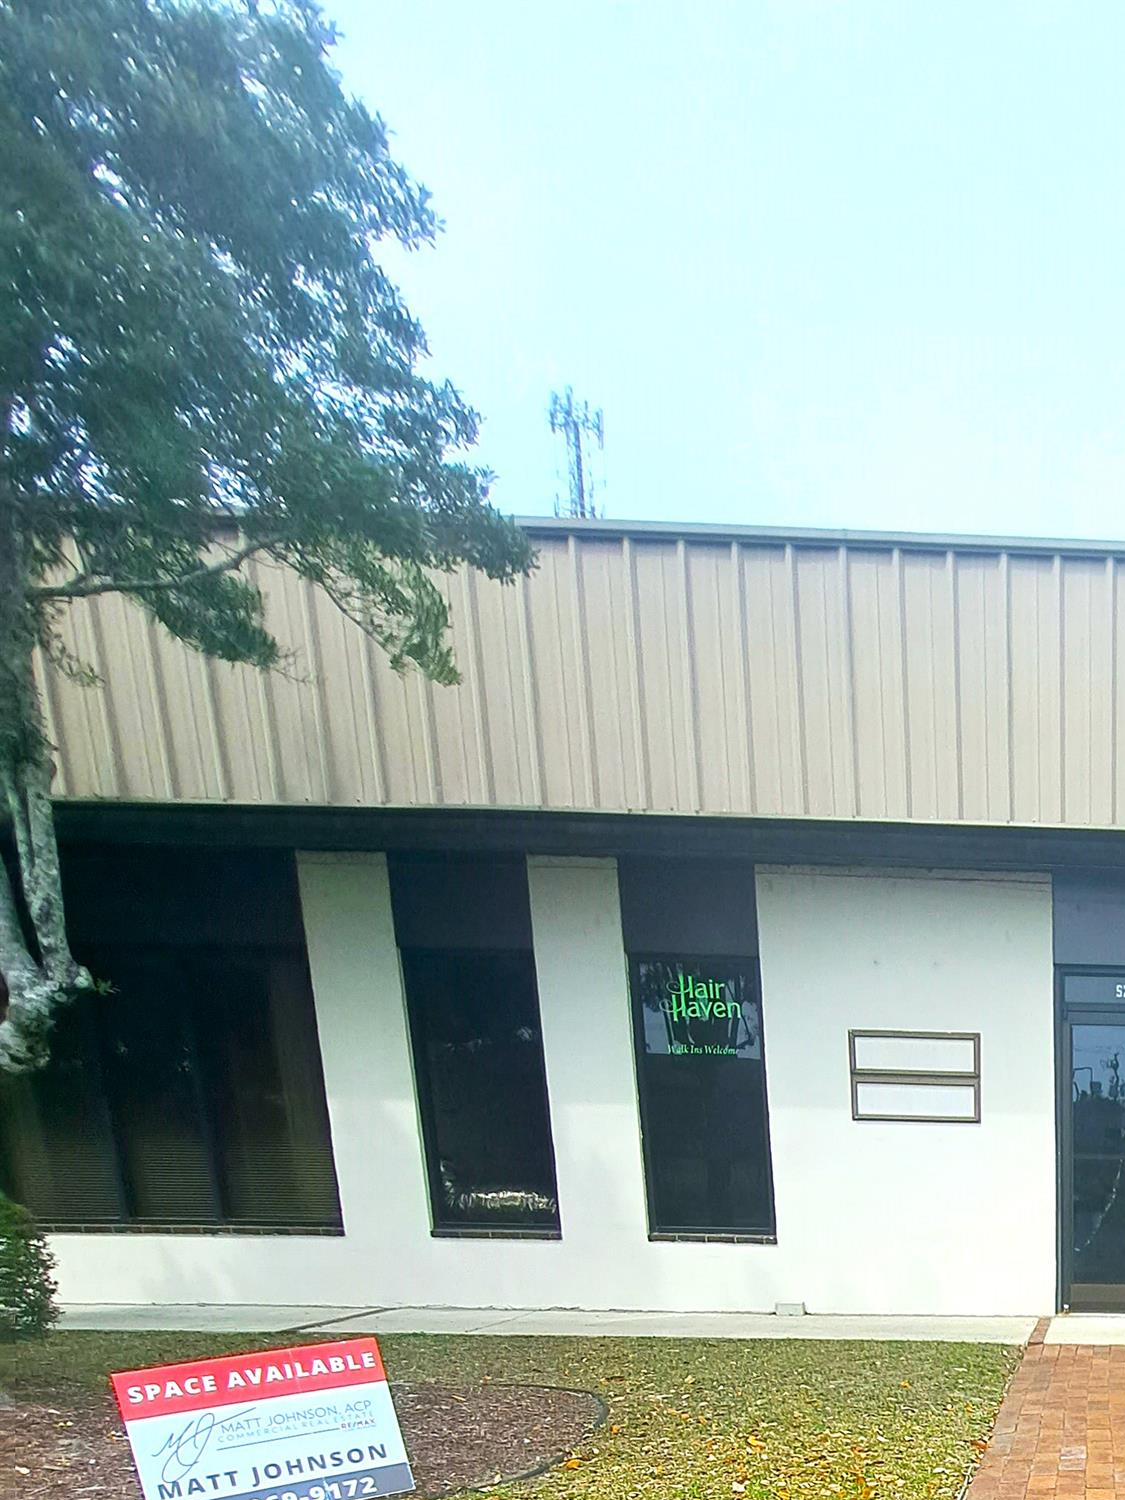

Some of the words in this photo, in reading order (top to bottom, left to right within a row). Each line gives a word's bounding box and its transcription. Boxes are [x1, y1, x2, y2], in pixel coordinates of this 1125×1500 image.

[666, 974, 726, 999] Hair
[659, 994, 742, 1022] Haven
[667, 1044, 689, 1055] Walk
[690, 1045, 703, 1055] Ins
[127, 1375, 218, 1405] SPACE
[227, 1352, 377, 1389] AVAILABLE
[217, 1424, 298, 1443] COMMERCIAL
[302, 1416, 331, 1428] REAL
[333, 1411, 374, 1423] ESTATE
[221, 1417, 262, 1434] MATT
[344, 1400, 372, 1413] ACP
[341, 1418, 376, 1429] RE/MAX
[157, 1470, 239, 1500] MATT
[251, 1443, 388, 1487] JOHNSON
